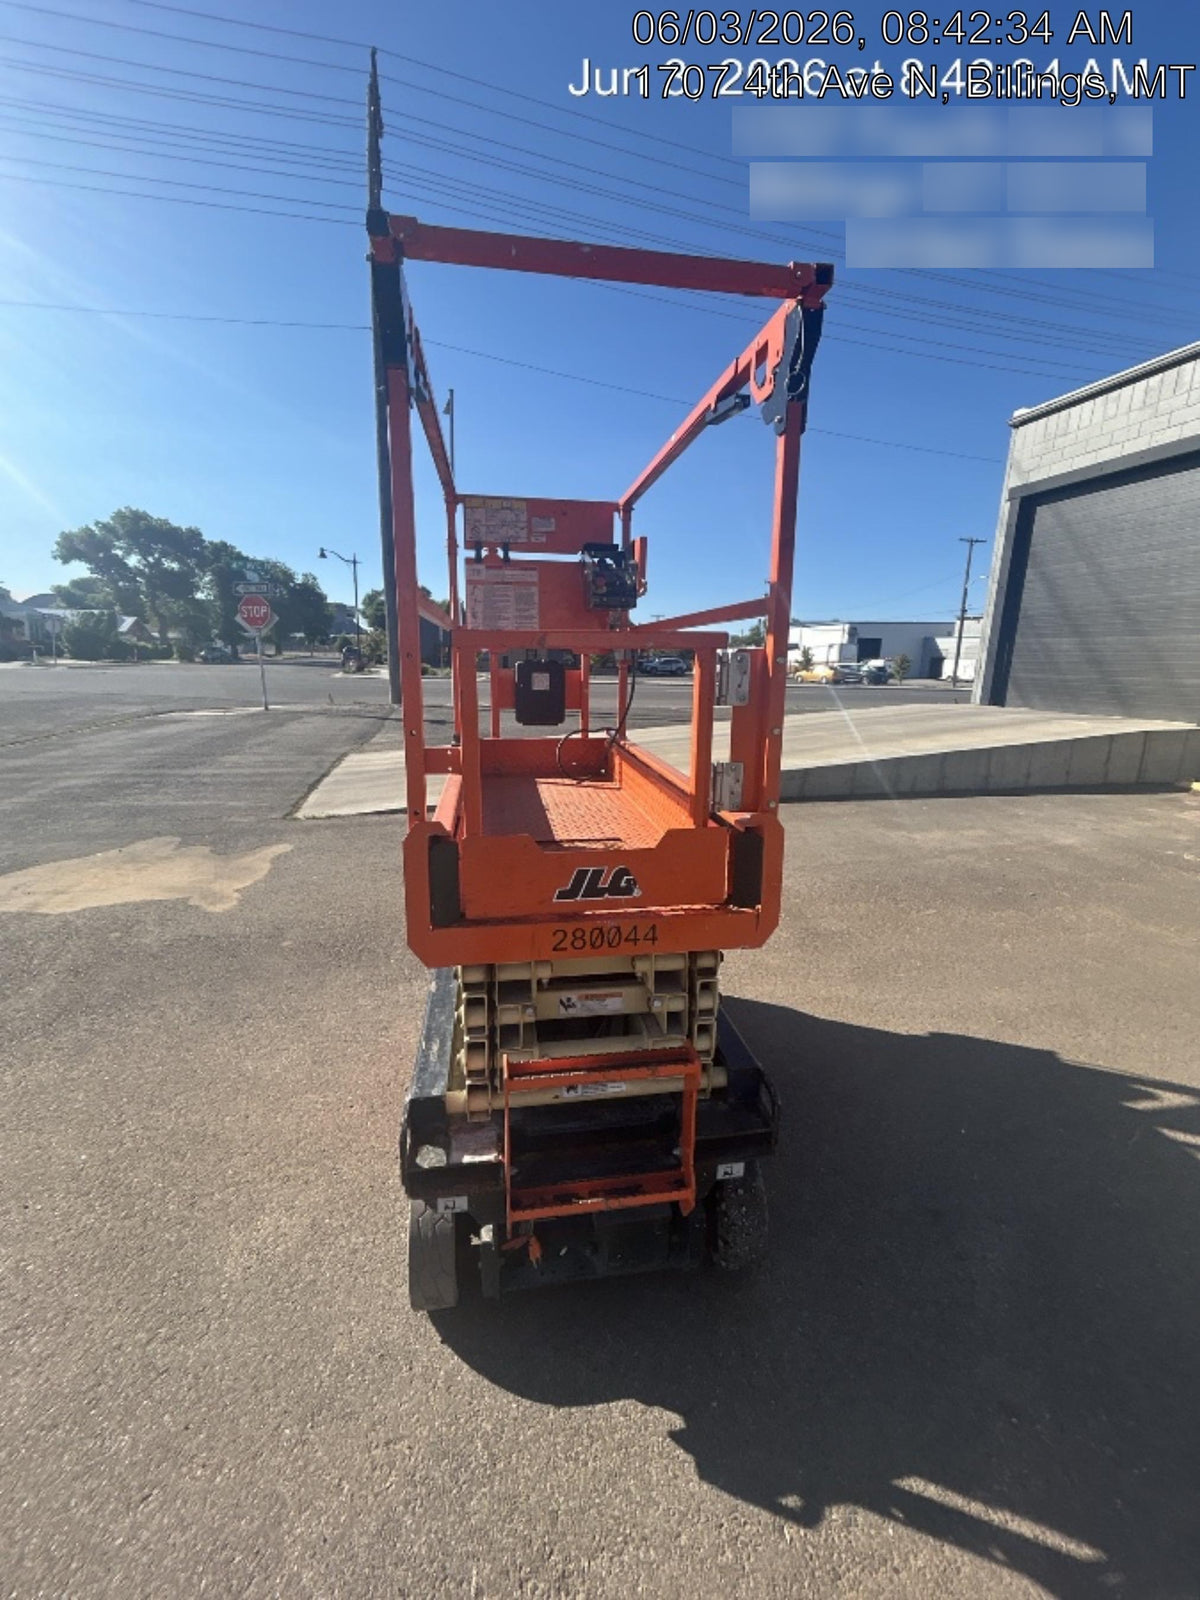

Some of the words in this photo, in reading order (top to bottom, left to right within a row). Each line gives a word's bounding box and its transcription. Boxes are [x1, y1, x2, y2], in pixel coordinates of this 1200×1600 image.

[241, 605, 267, 618] STOP
[552, 865, 638, 902] JLG
[551, 924, 658, 952] 280044
